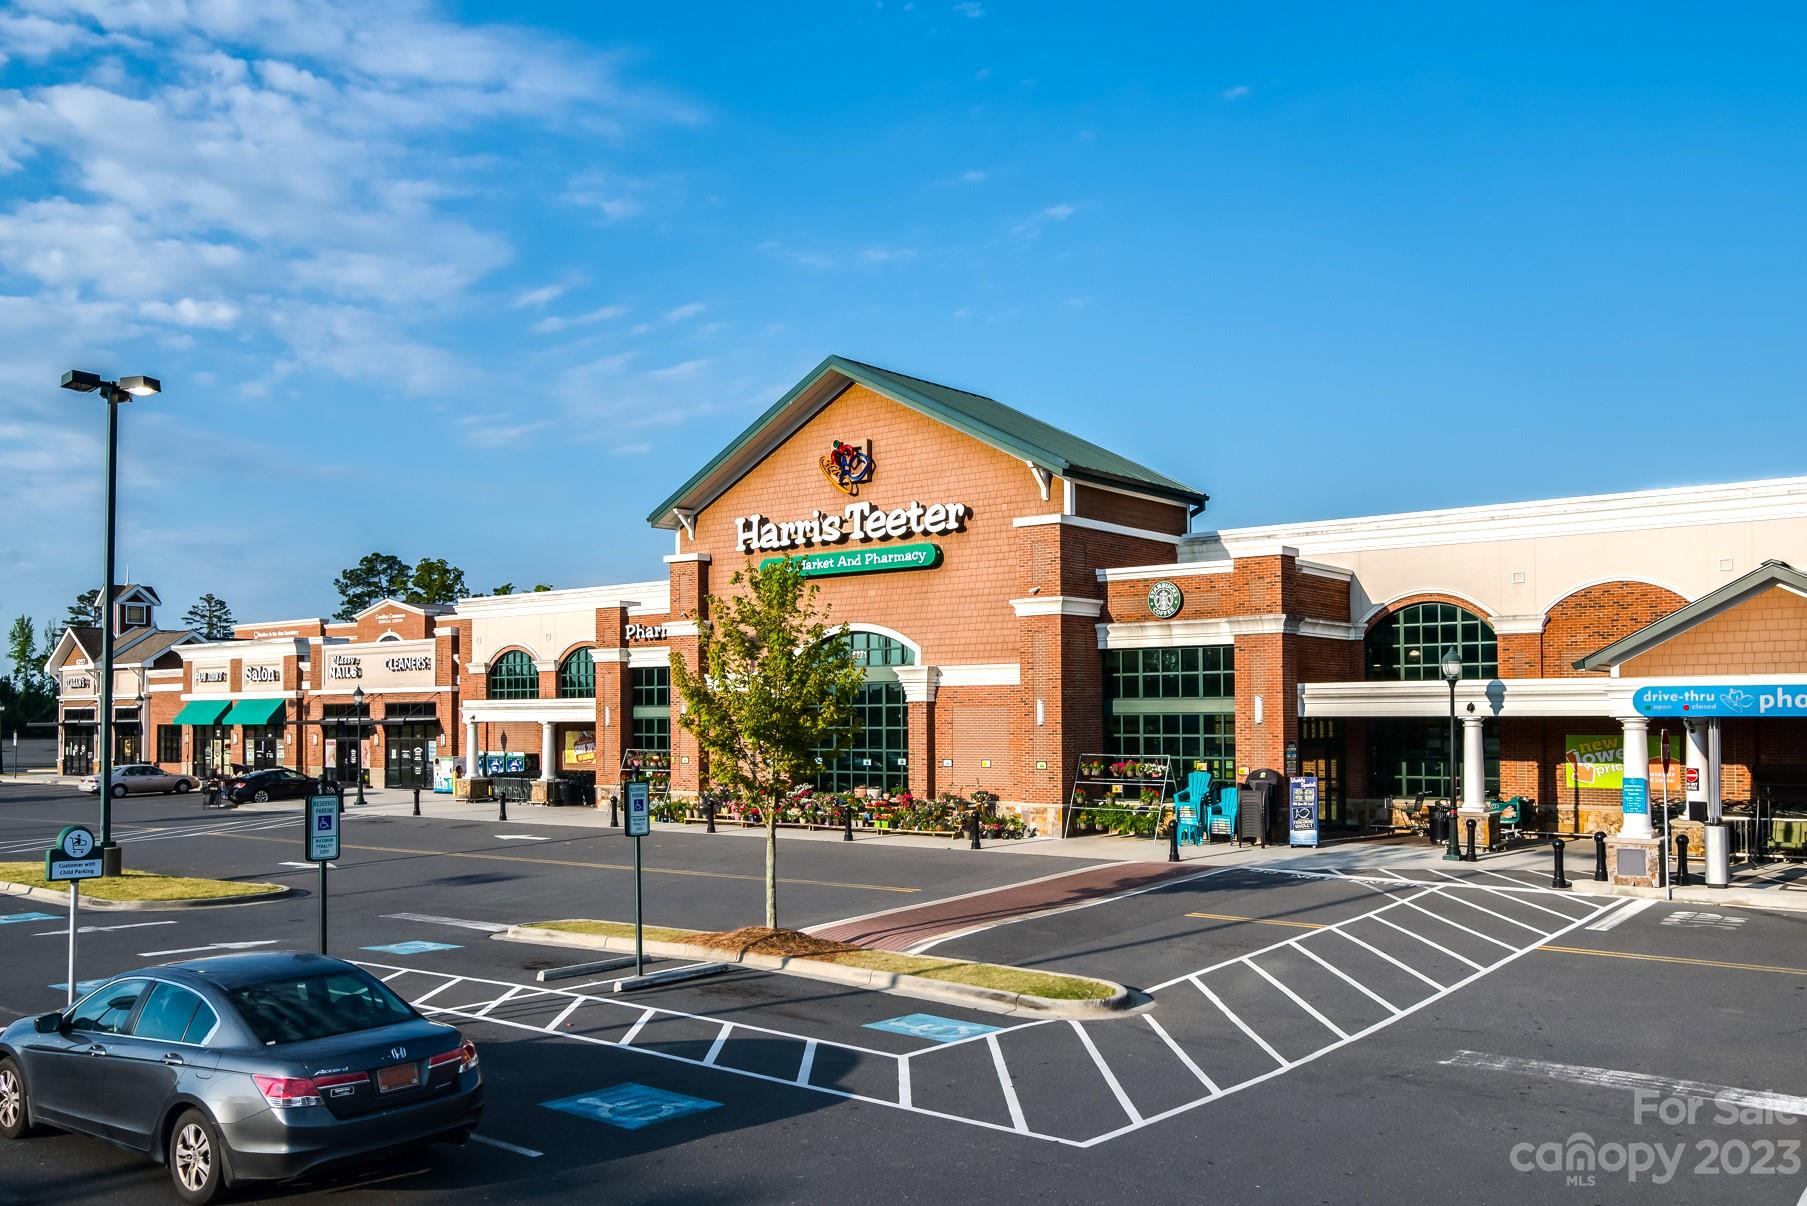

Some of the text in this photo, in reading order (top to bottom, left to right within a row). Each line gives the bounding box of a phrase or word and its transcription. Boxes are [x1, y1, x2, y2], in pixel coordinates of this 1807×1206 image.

[734, 501, 965, 551] Harris Teeter
[837, 555, 862, 568] And
[864, 550, 927, 566] Pharmacy
[1149, 583, 1178, 598] STARBUCKS
[1153, 607, 1175, 616] COFFEE
[625, 623, 667, 640] Phar
[385, 657, 428, 671] CLEANERS
[245, 666, 275, 681] Salon
[330, 666, 358, 679] NAILS
[1643, 690, 1715, 702] drive-thru
[1579, 738, 1618, 753] new
[1574, 748, 1623, 764] lowe
[1596, 764, 1623, 777] pric
[313, 1066, 349, 1076] Accord
